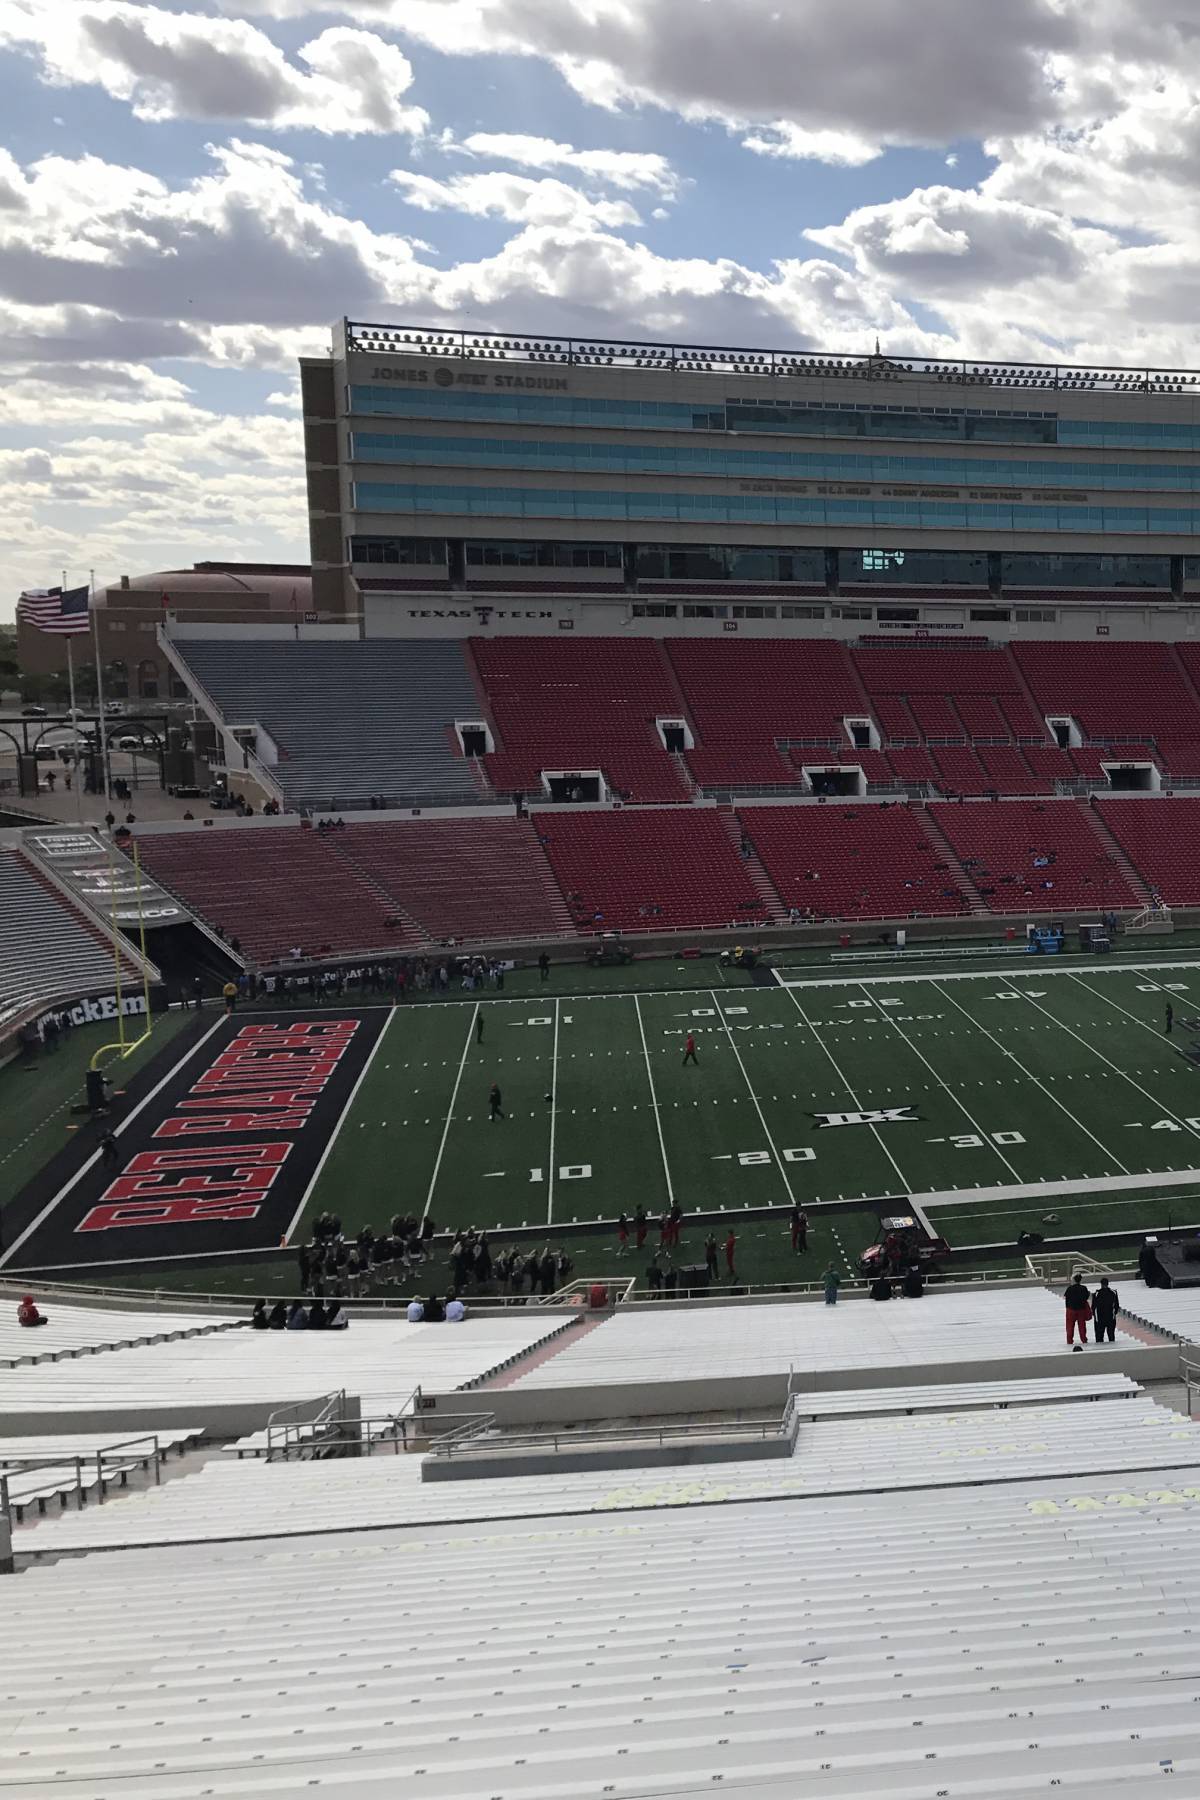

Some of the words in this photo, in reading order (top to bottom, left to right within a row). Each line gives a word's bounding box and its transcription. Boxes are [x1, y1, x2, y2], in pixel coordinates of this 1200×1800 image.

[370, 367, 428, 382] JONES
[457, 372, 488, 384] AT&T
[495, 375, 568, 390] STADIUM
[407, 610, 471, 618] TEXAS
[108, 908, 179, 919] GEICO
[1136, 983, 1190, 992] 50
[866, 1013, 945, 1024] JONES
[663, 1022, 785, 1035] STADIUM
[151, 1018, 362, 1139] RAIDERS
[953, 1130, 1028, 1149] 30
[737, 1146, 817, 1166] 20
[529, 1164, 593, 1183] 10
[74, 1140, 295, 1232] RED
